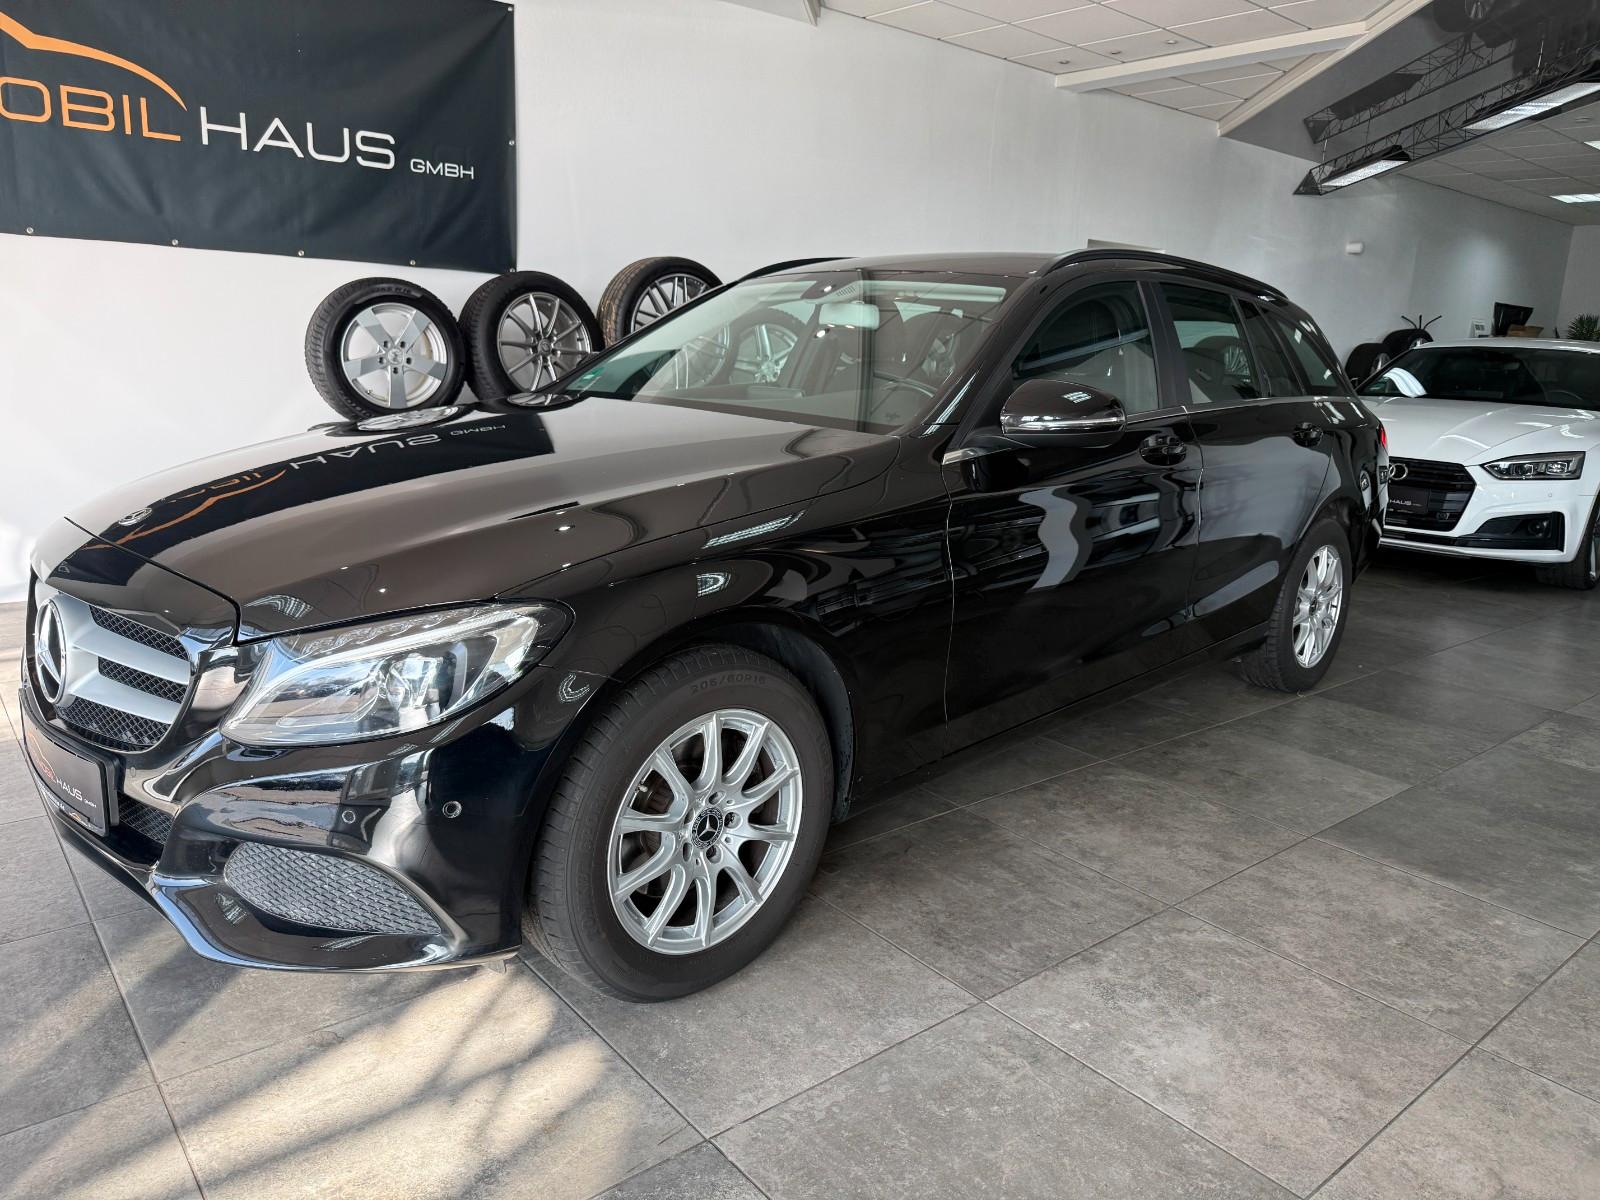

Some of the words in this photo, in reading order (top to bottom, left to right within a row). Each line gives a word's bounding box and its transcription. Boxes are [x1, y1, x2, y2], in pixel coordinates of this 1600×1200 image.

[200, 106, 396, 170] HAUS
[410, 158, 475, 180] GMBH
[56, 779, 83, 801] HAUS
